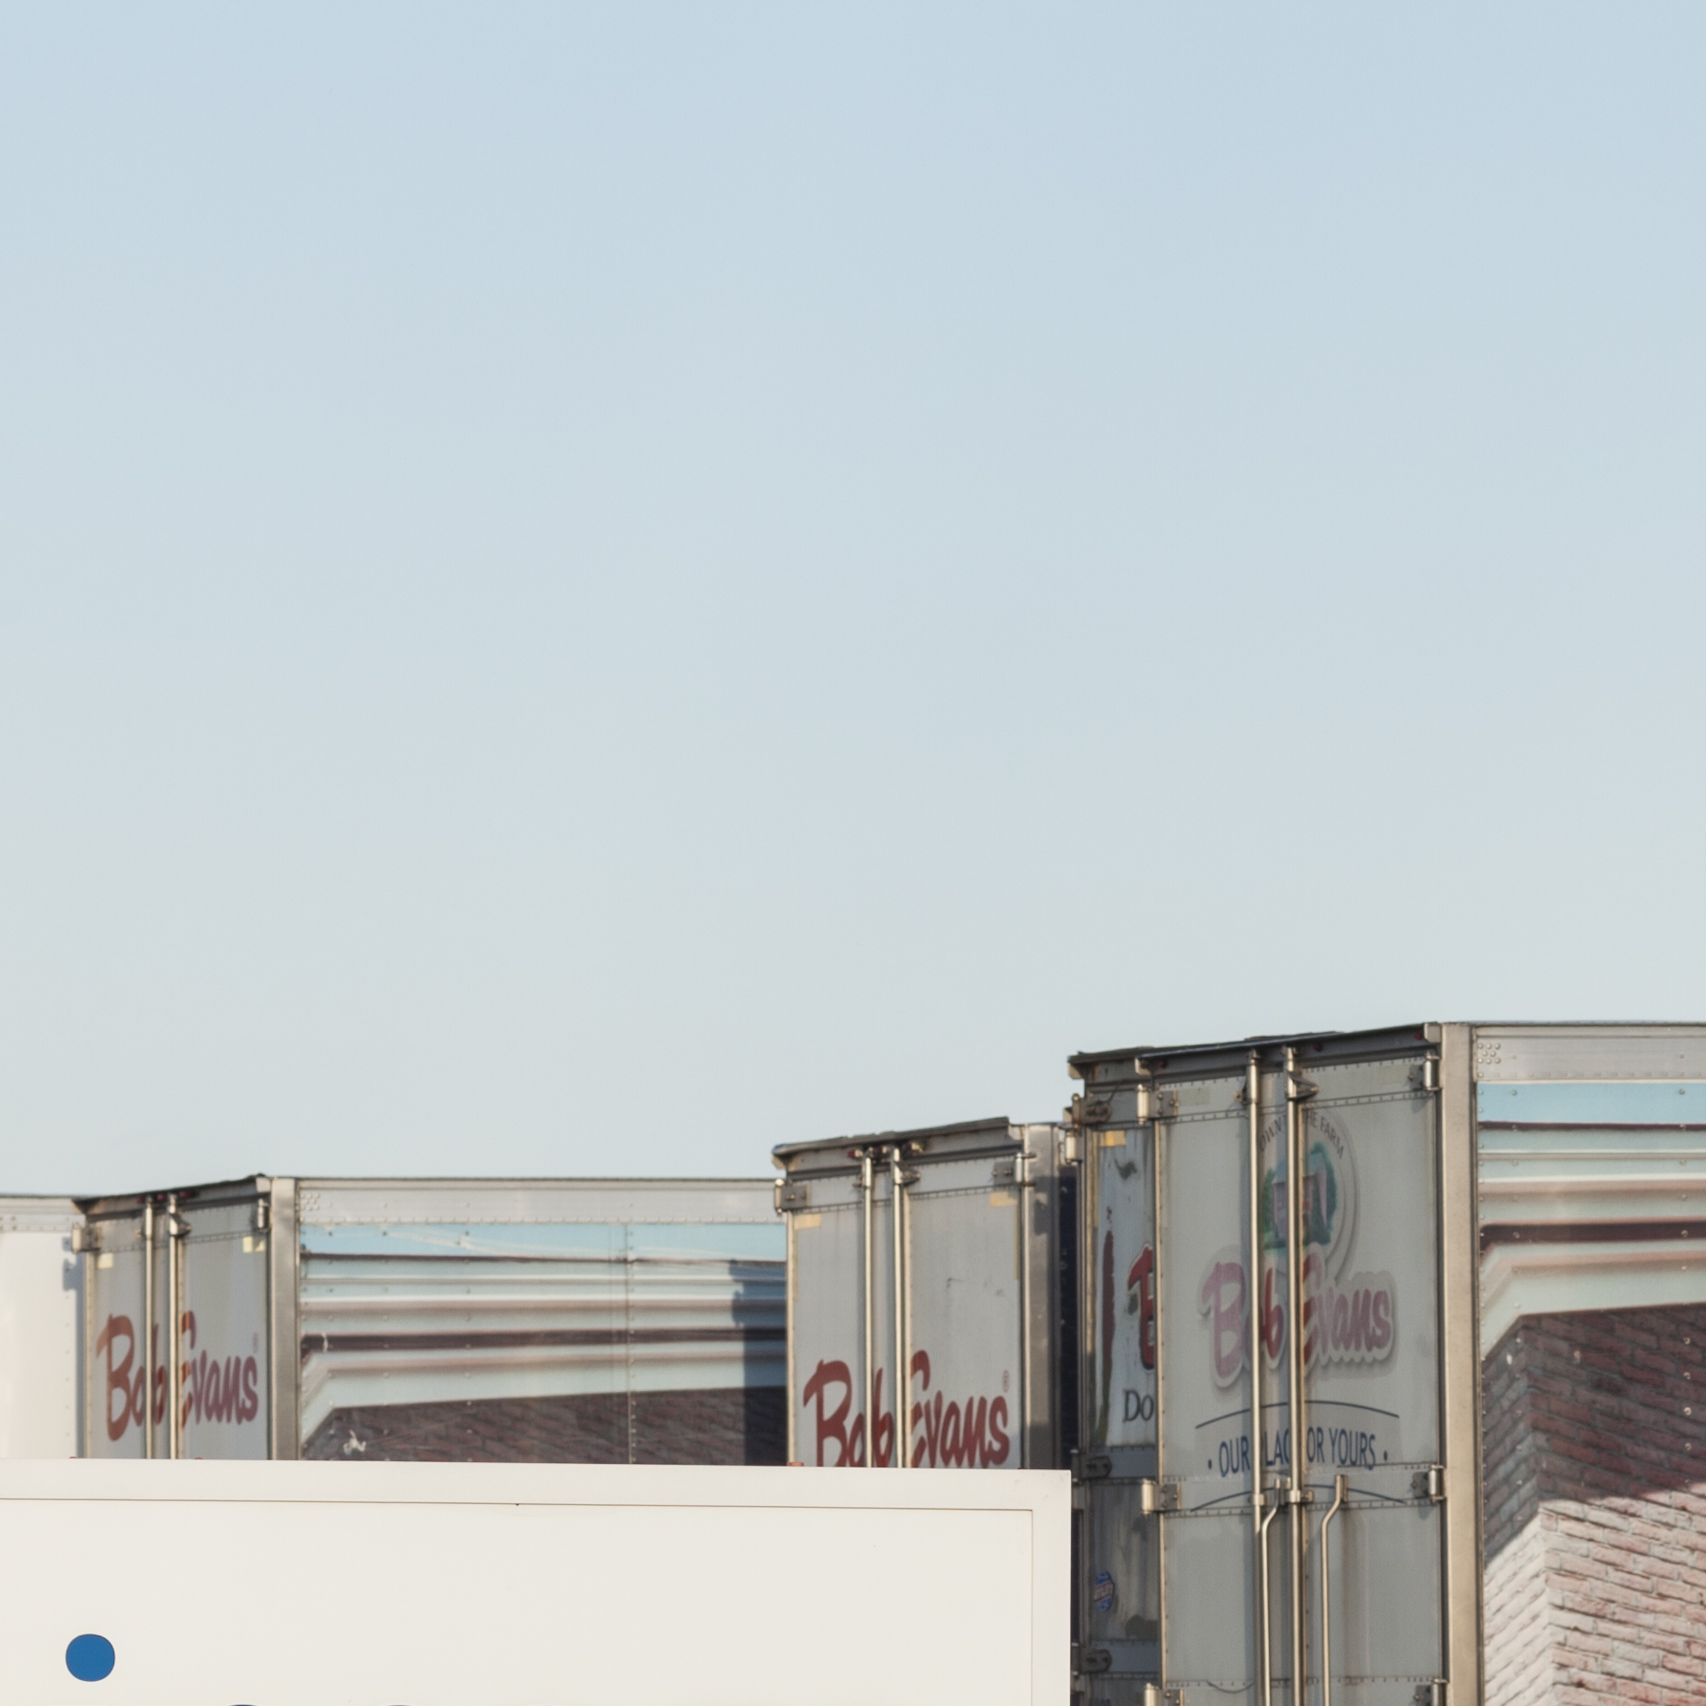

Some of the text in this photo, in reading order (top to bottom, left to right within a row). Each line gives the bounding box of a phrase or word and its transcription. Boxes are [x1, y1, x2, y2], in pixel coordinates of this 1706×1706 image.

[1303, 1252, 1391, 1366] Evans
[96, 1310, 259, 1441] Bob Evans
[910, 1349, 1011, 1469] Evans
[1219, 1436, 1251, 1477] OUR
[1307, 1427, 1324, 1463] OR
[1329, 1428, 1376, 1470] YOURS
